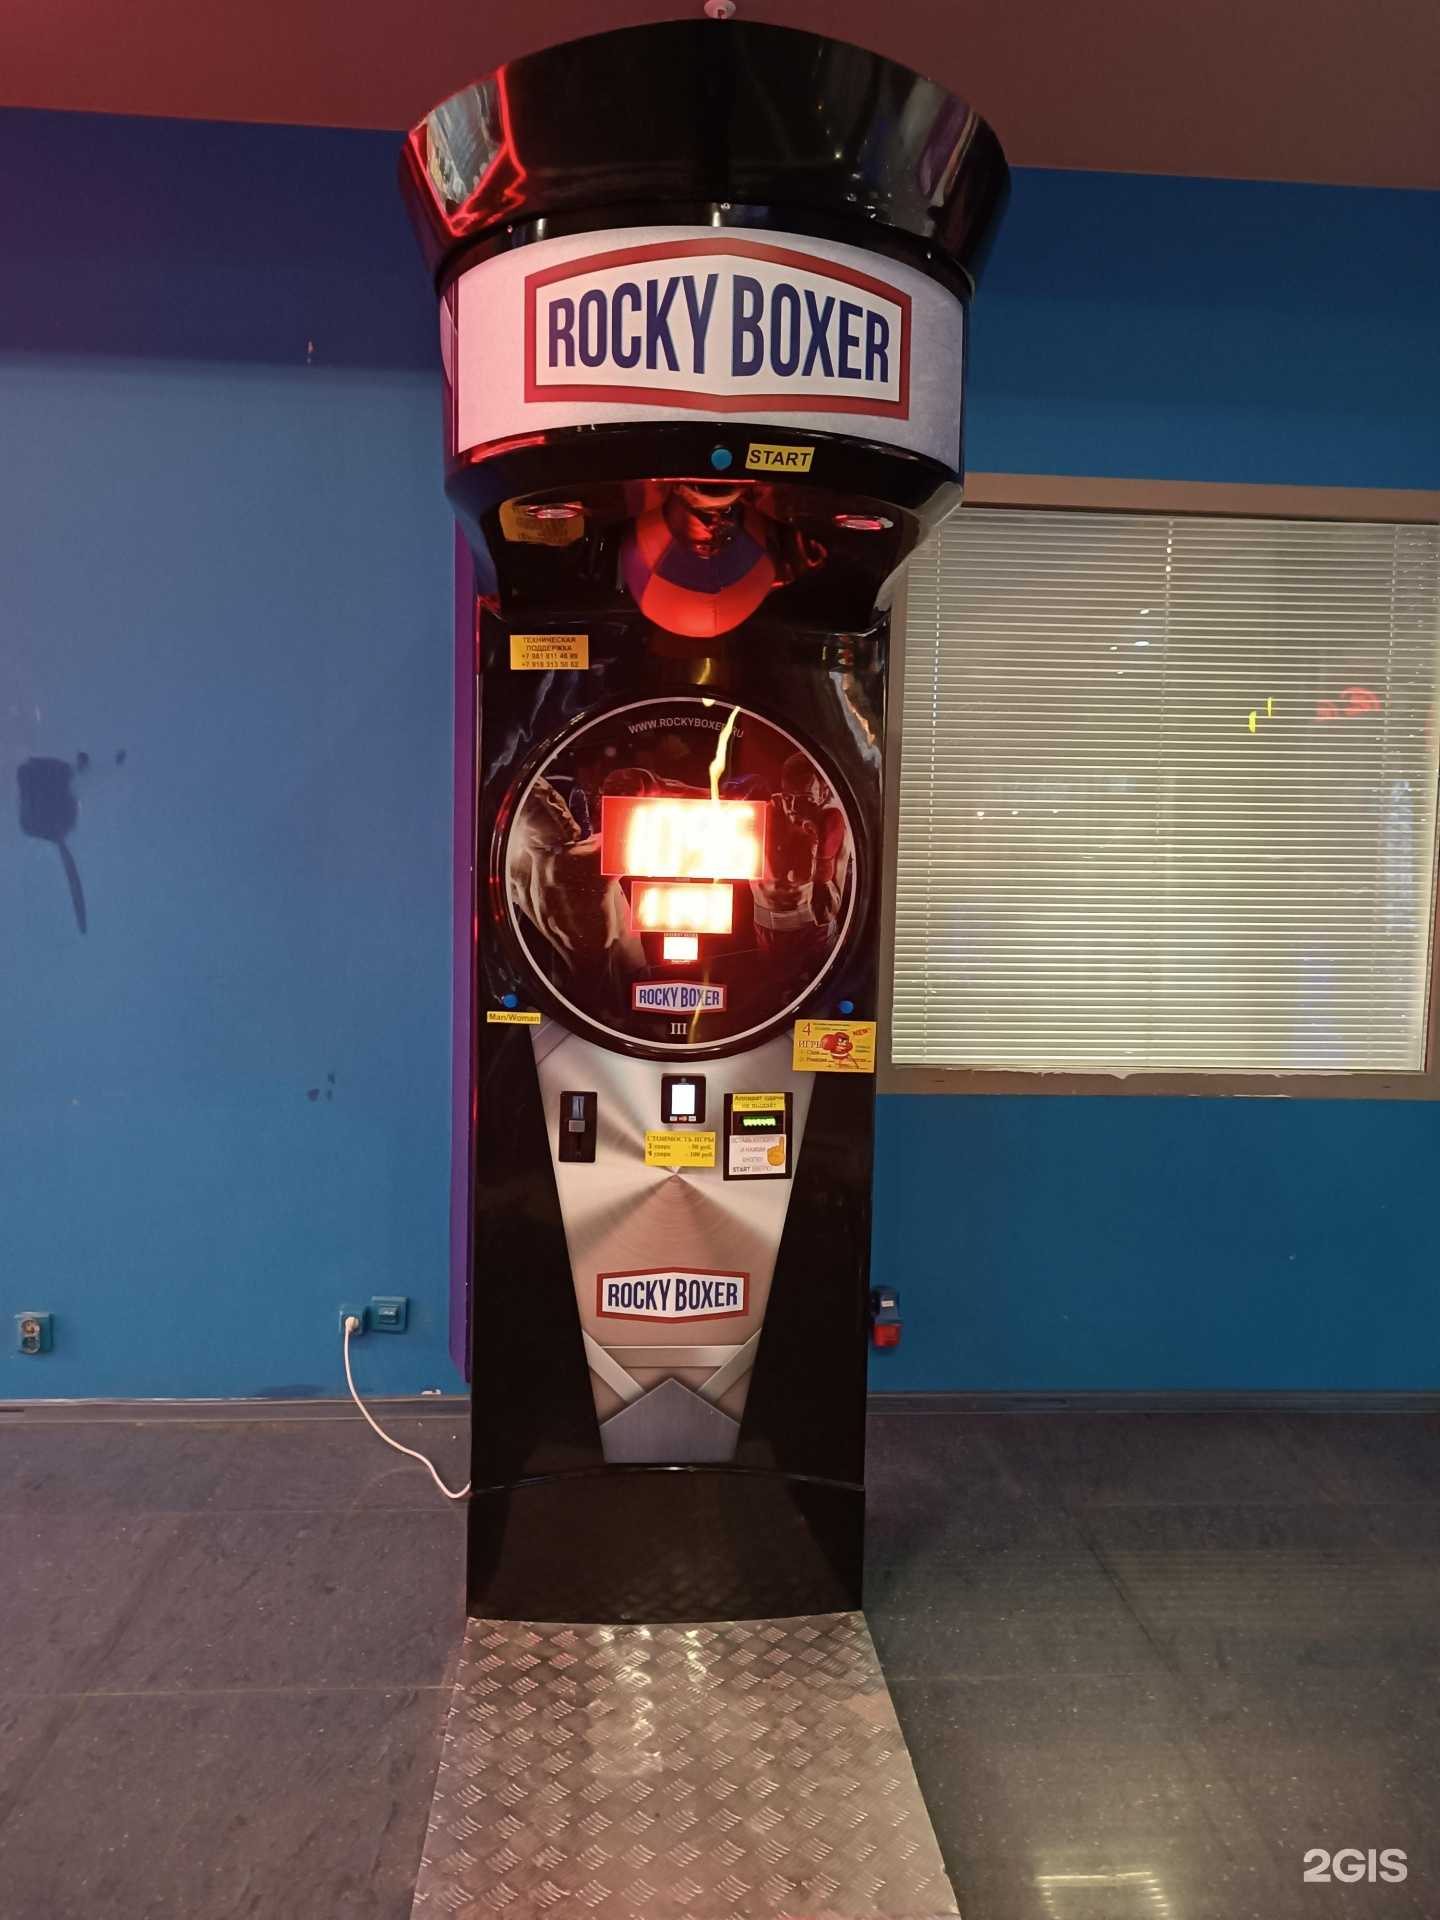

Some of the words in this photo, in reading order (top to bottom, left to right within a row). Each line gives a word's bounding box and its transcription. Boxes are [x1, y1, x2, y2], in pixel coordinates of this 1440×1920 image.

[548, 273, 719, 375] ROCKY
[731, 274, 889, 383] BOXER
[749, 449, 811, 467] START
[628, 717, 744, 738] WWW.ROCKYBOXERU
[639, 987, 678, 1007] ROCKY
[681, 987, 720, 1008] BOXER
[489, 1013, 540, 1023] Man/Woman
[670, 1022, 688, 1035] III
[802, 1022, 812, 1036] 4
[608, 1278, 671, 1311] ROCKY
[675, 1279, 738, 1311] BOXER
